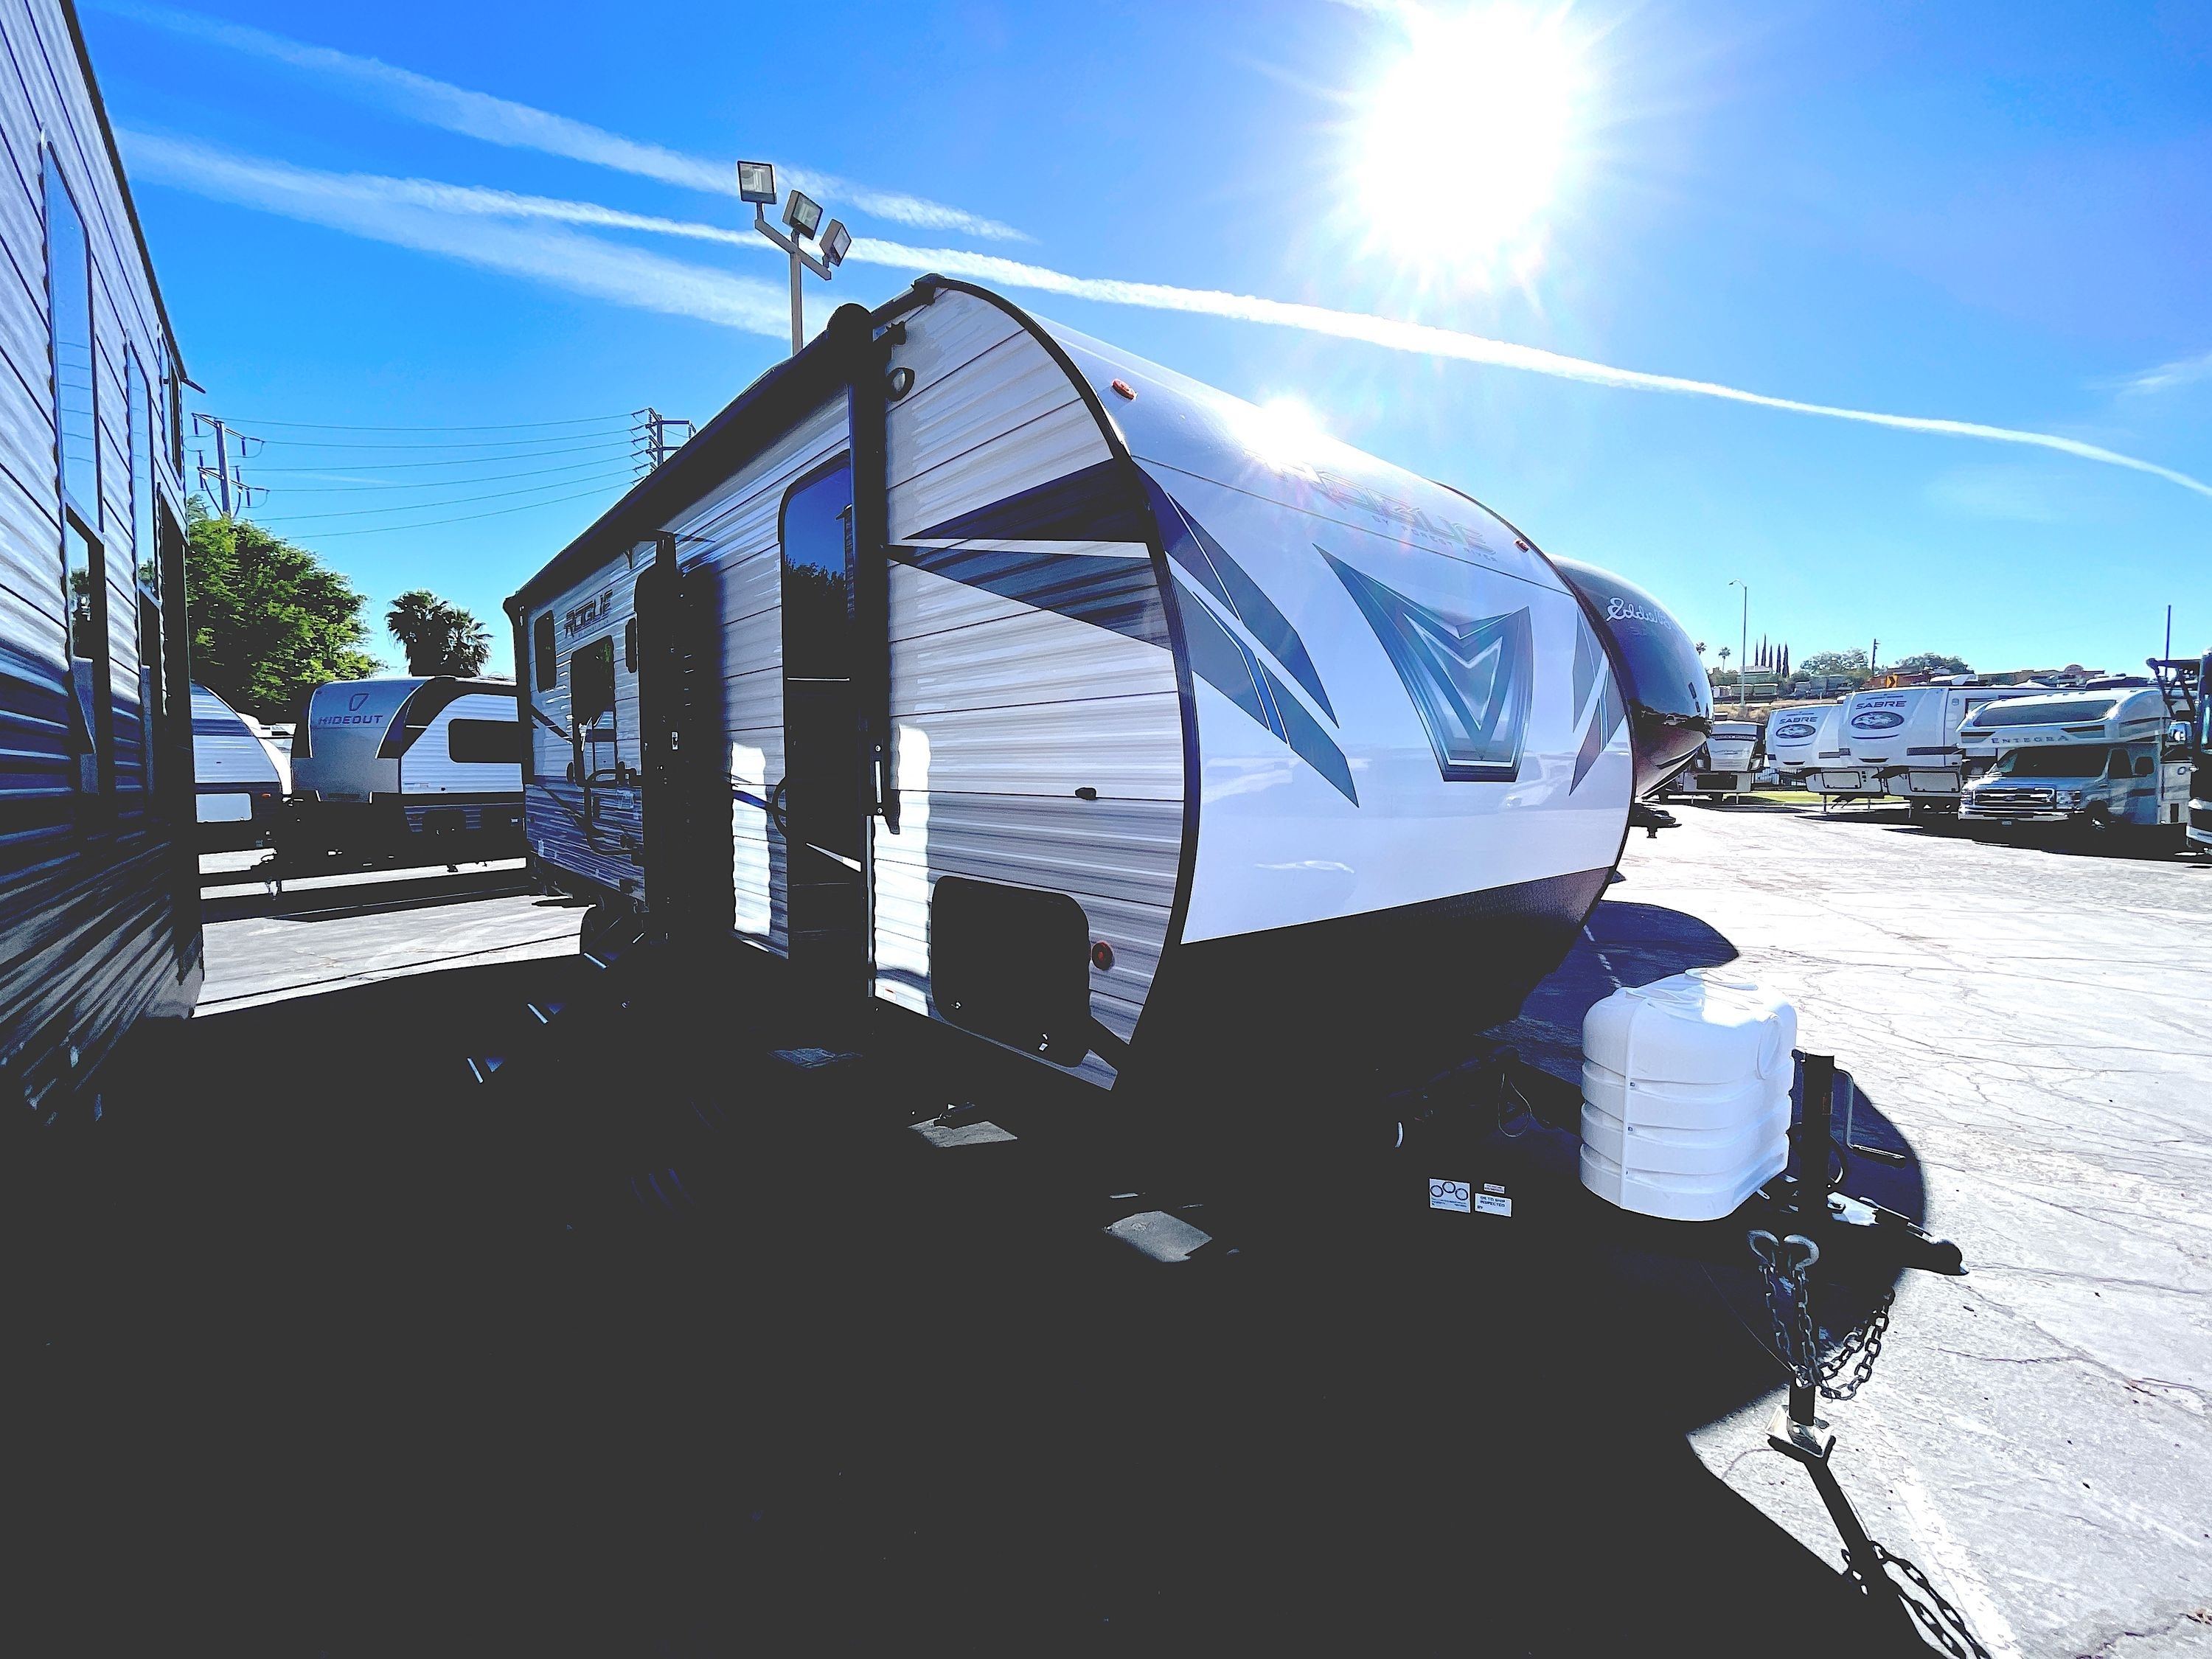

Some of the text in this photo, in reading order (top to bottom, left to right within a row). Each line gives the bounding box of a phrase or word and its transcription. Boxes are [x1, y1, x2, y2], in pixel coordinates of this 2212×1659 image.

[563, 589, 613, 639] ROGUE
[1855, 700, 1907, 710] SABRE
[318, 715, 383, 725] HIDEOUT
[1778, 717, 1818, 725] SABRE
[1991, 736, 2070, 744] ENTEGRA
